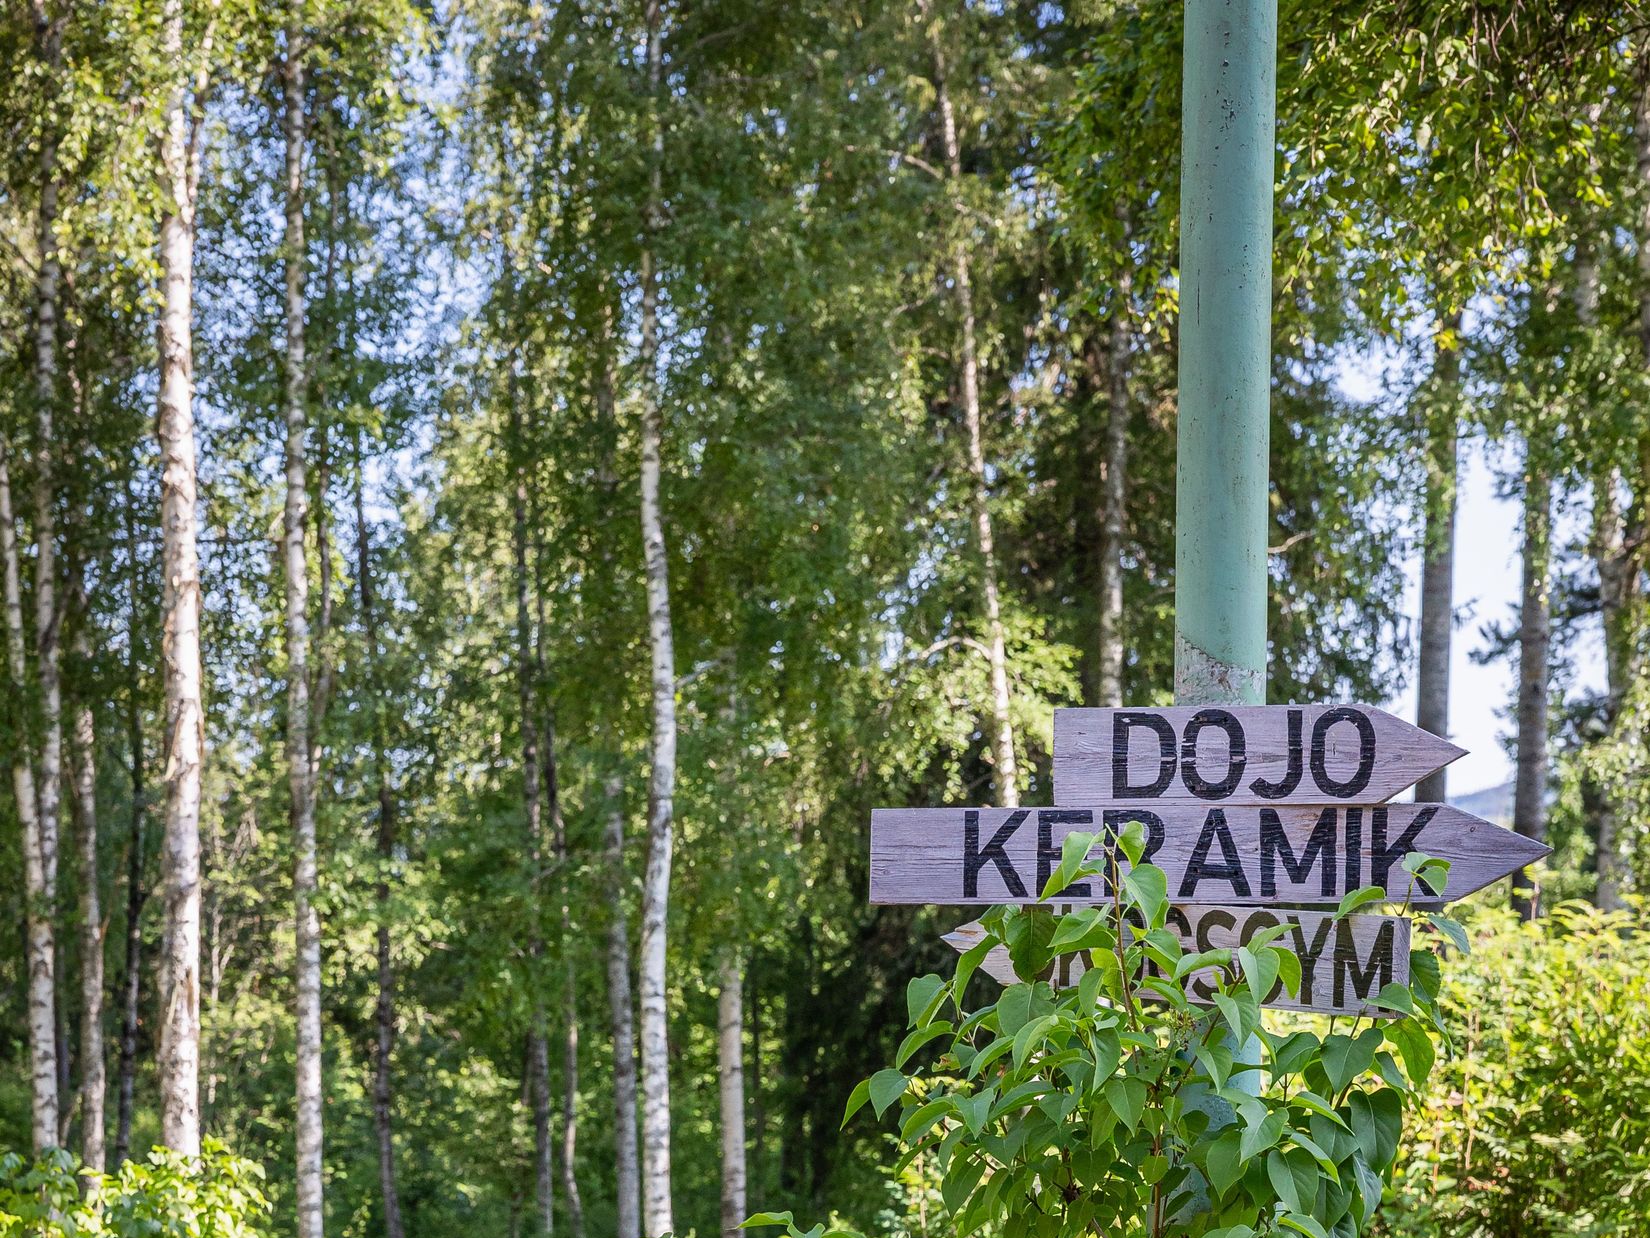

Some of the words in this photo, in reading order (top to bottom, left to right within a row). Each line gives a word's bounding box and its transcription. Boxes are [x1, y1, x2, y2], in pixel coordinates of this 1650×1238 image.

[1112, 707, 1376, 800] DOJO
[963, 807, 1440, 898] KERAMIK
[1019, 903, 1395, 1012] OGSGYM
